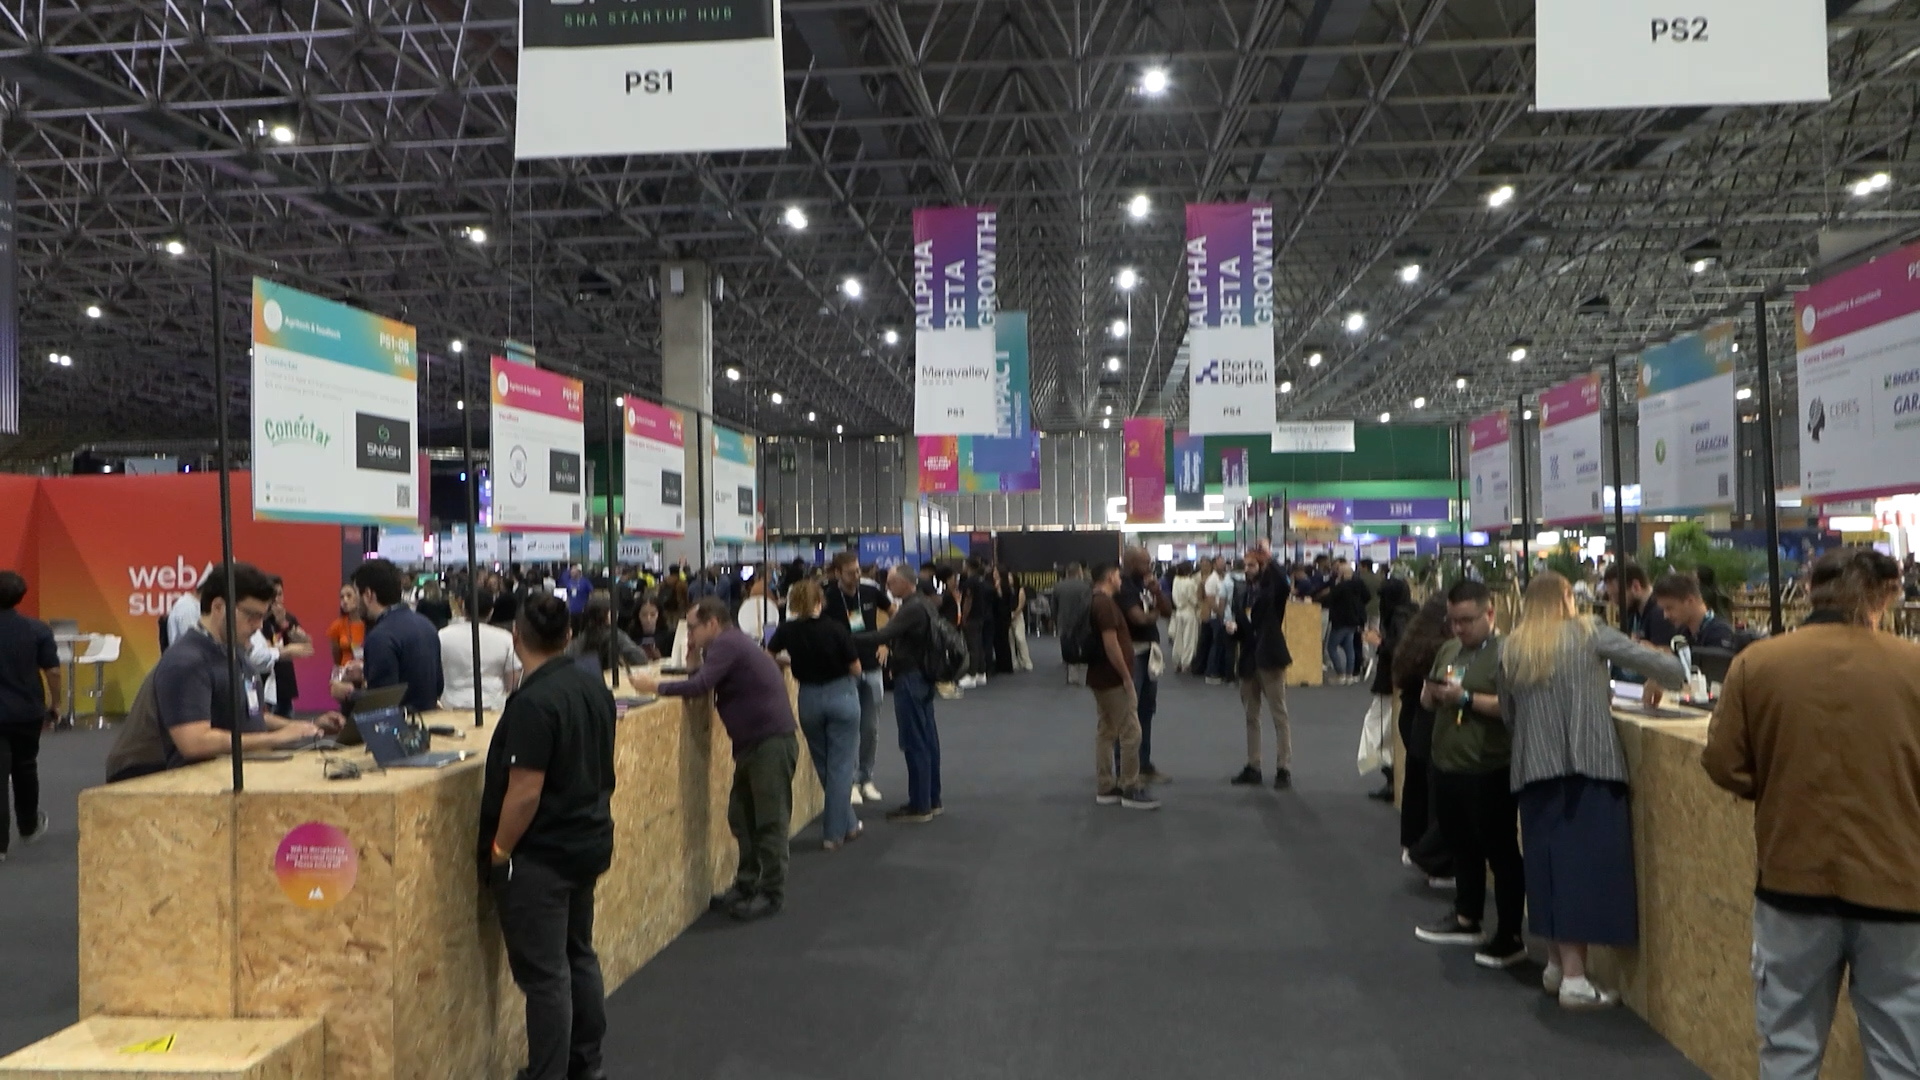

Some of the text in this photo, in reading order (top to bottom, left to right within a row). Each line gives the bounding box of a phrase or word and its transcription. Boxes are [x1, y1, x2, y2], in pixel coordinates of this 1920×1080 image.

[564, 6, 733, 28] SNA STARTUP HUB
[1651, 17, 1709, 42] PS2
[625, 69, 673, 95] PS1
[977, 211, 997, 329] GROWTH
[1252, 207, 1274, 326] GROWTH
[914, 239, 934, 331] ALPHA
[945, 258, 966, 330] BETA
[1187, 235, 1208, 329] ALPHA
[1219, 255, 1241, 329] BETA
[921, 364, 990, 382] Maravalley
[1221, 358, 1264, 371] Porto
[1221, 371, 1268, 387] Digital
[1892, 368, 1920, 389] BNDES
[1829, 398, 1860, 418] CERES
[366, 441, 402, 460] SNASH
[1389, 503, 1413, 517] IBM
[128, 554, 198, 589] web
